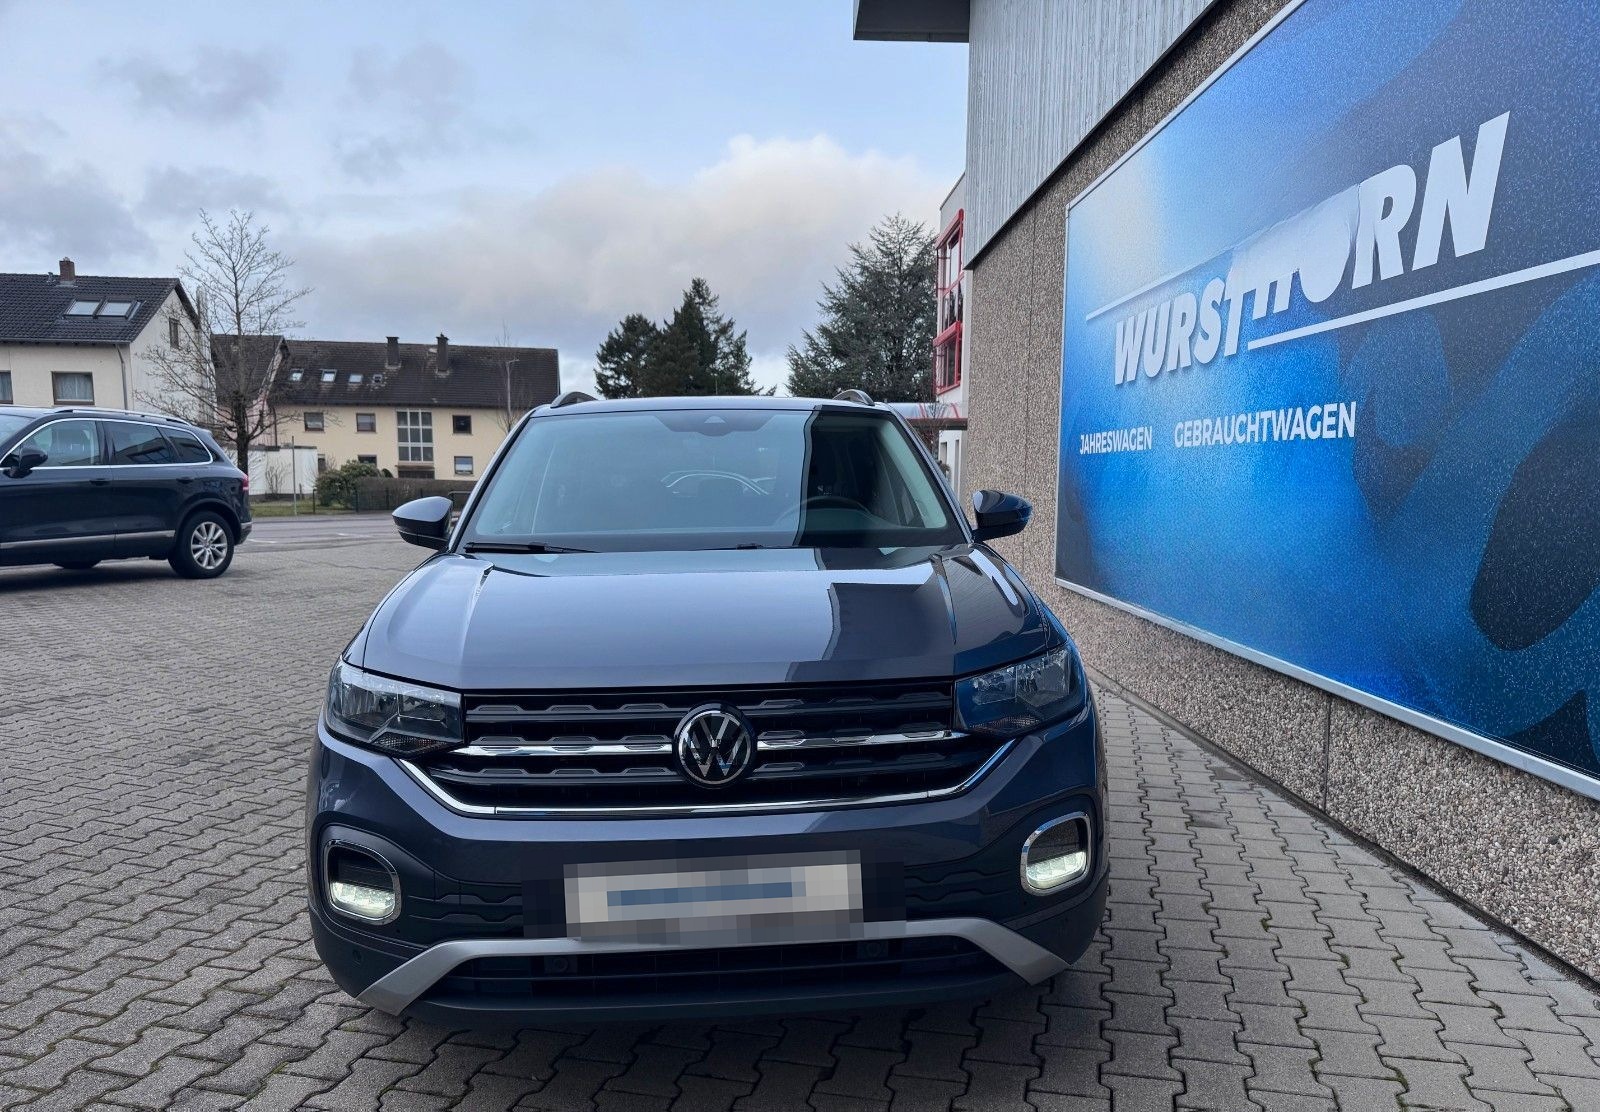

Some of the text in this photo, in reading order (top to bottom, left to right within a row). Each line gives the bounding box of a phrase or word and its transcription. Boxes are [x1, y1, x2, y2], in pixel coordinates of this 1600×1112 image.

[1079, 401, 1357, 455] JAHRESWAGEN GEBRAUCHTWAGEN
[681, 711, 749, 780] VW
